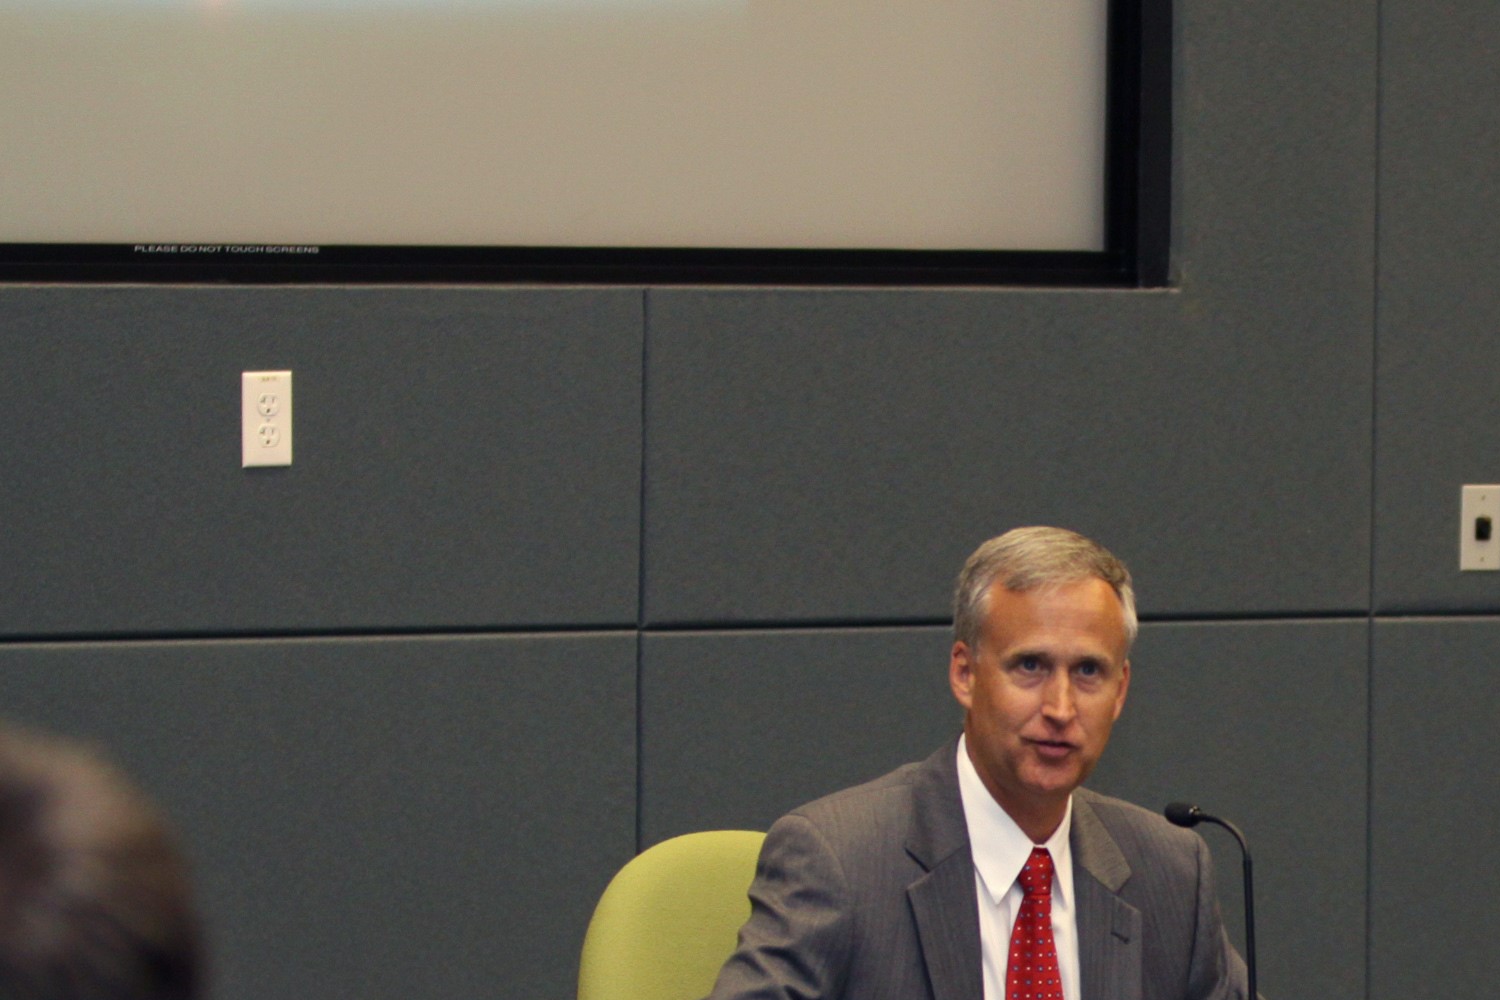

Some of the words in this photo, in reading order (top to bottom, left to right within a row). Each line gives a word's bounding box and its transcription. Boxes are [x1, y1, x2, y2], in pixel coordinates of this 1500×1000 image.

[134, 245, 178, 253] PLEASE
[180, 245, 197, 253] DO
[199, 245, 222, 253] NOT
[224, 246, 264, 254] TOUCH
[266, 246, 319, 254] SCREENS
